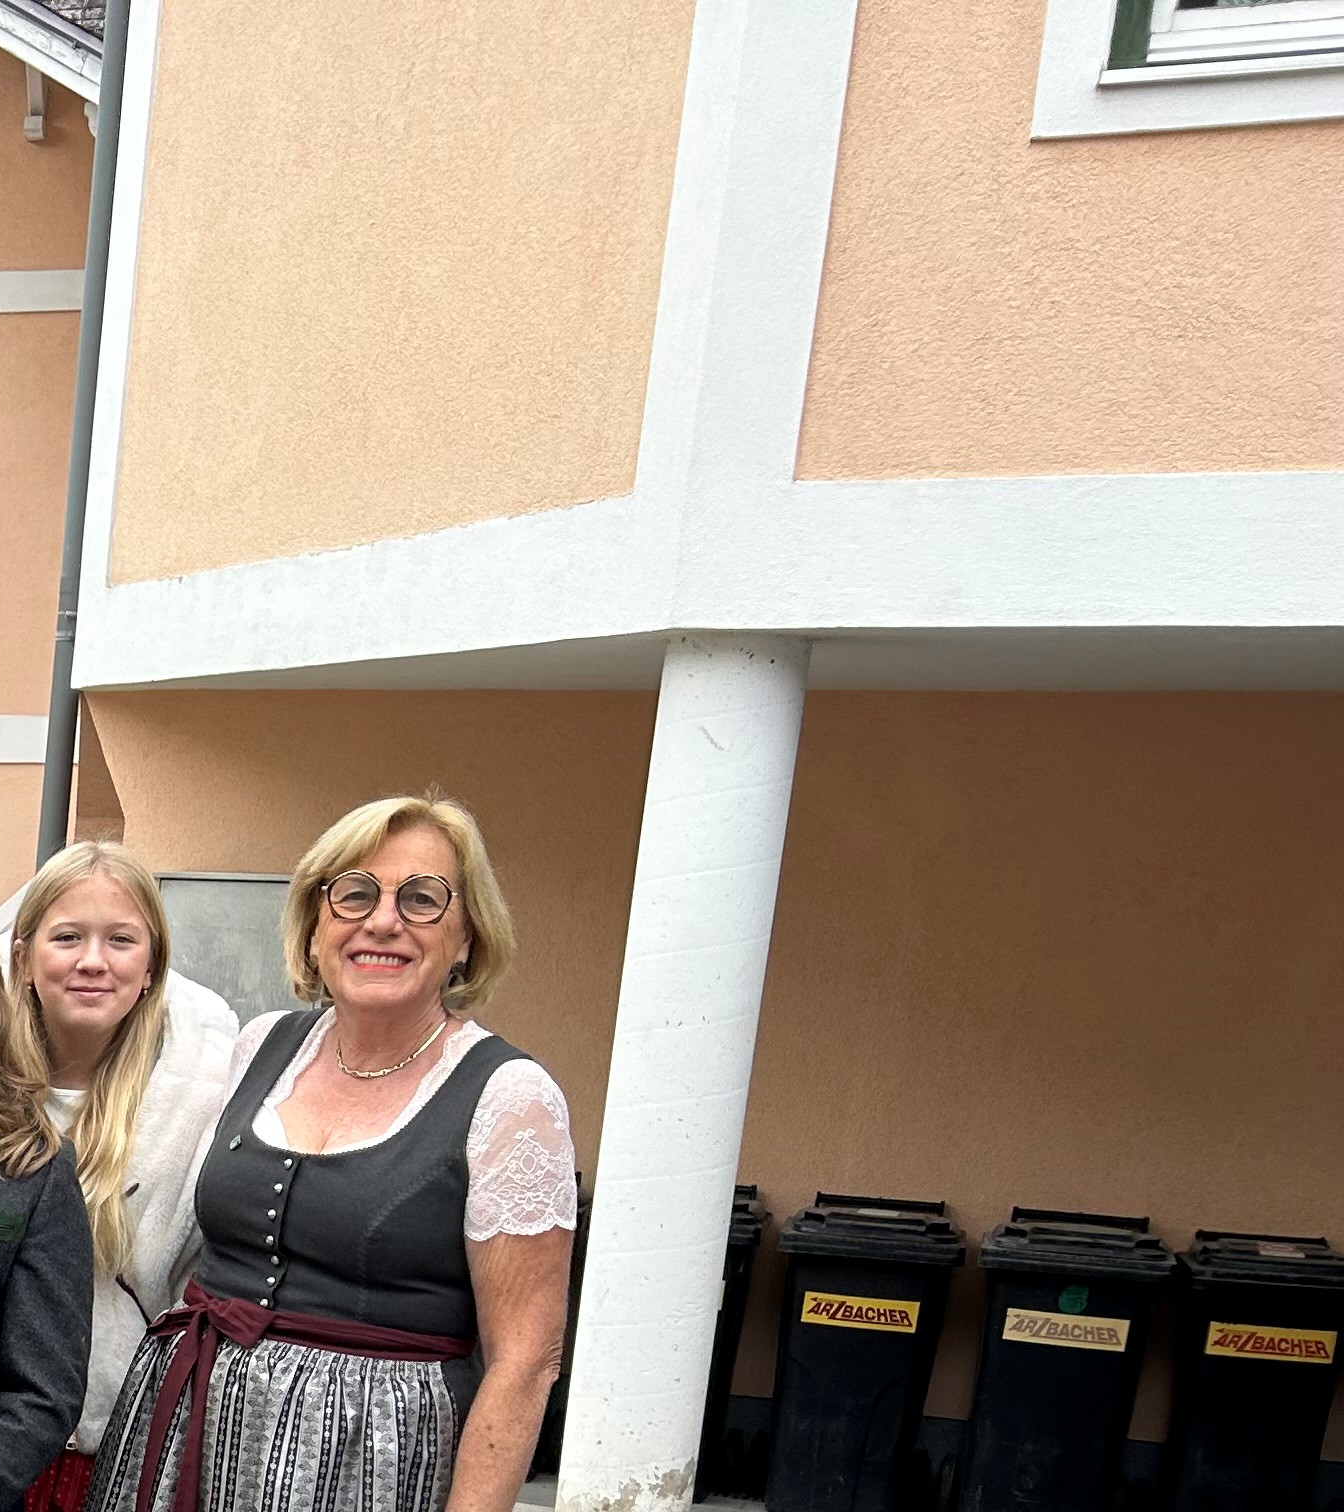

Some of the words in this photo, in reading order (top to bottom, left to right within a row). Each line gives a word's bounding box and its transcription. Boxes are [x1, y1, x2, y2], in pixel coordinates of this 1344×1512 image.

[807, 1300, 914, 1328] ARZBACHER
[1009, 1317, 1123, 1346] ARZBACHER
[1212, 1331, 1331, 1360] ARZBACHER
